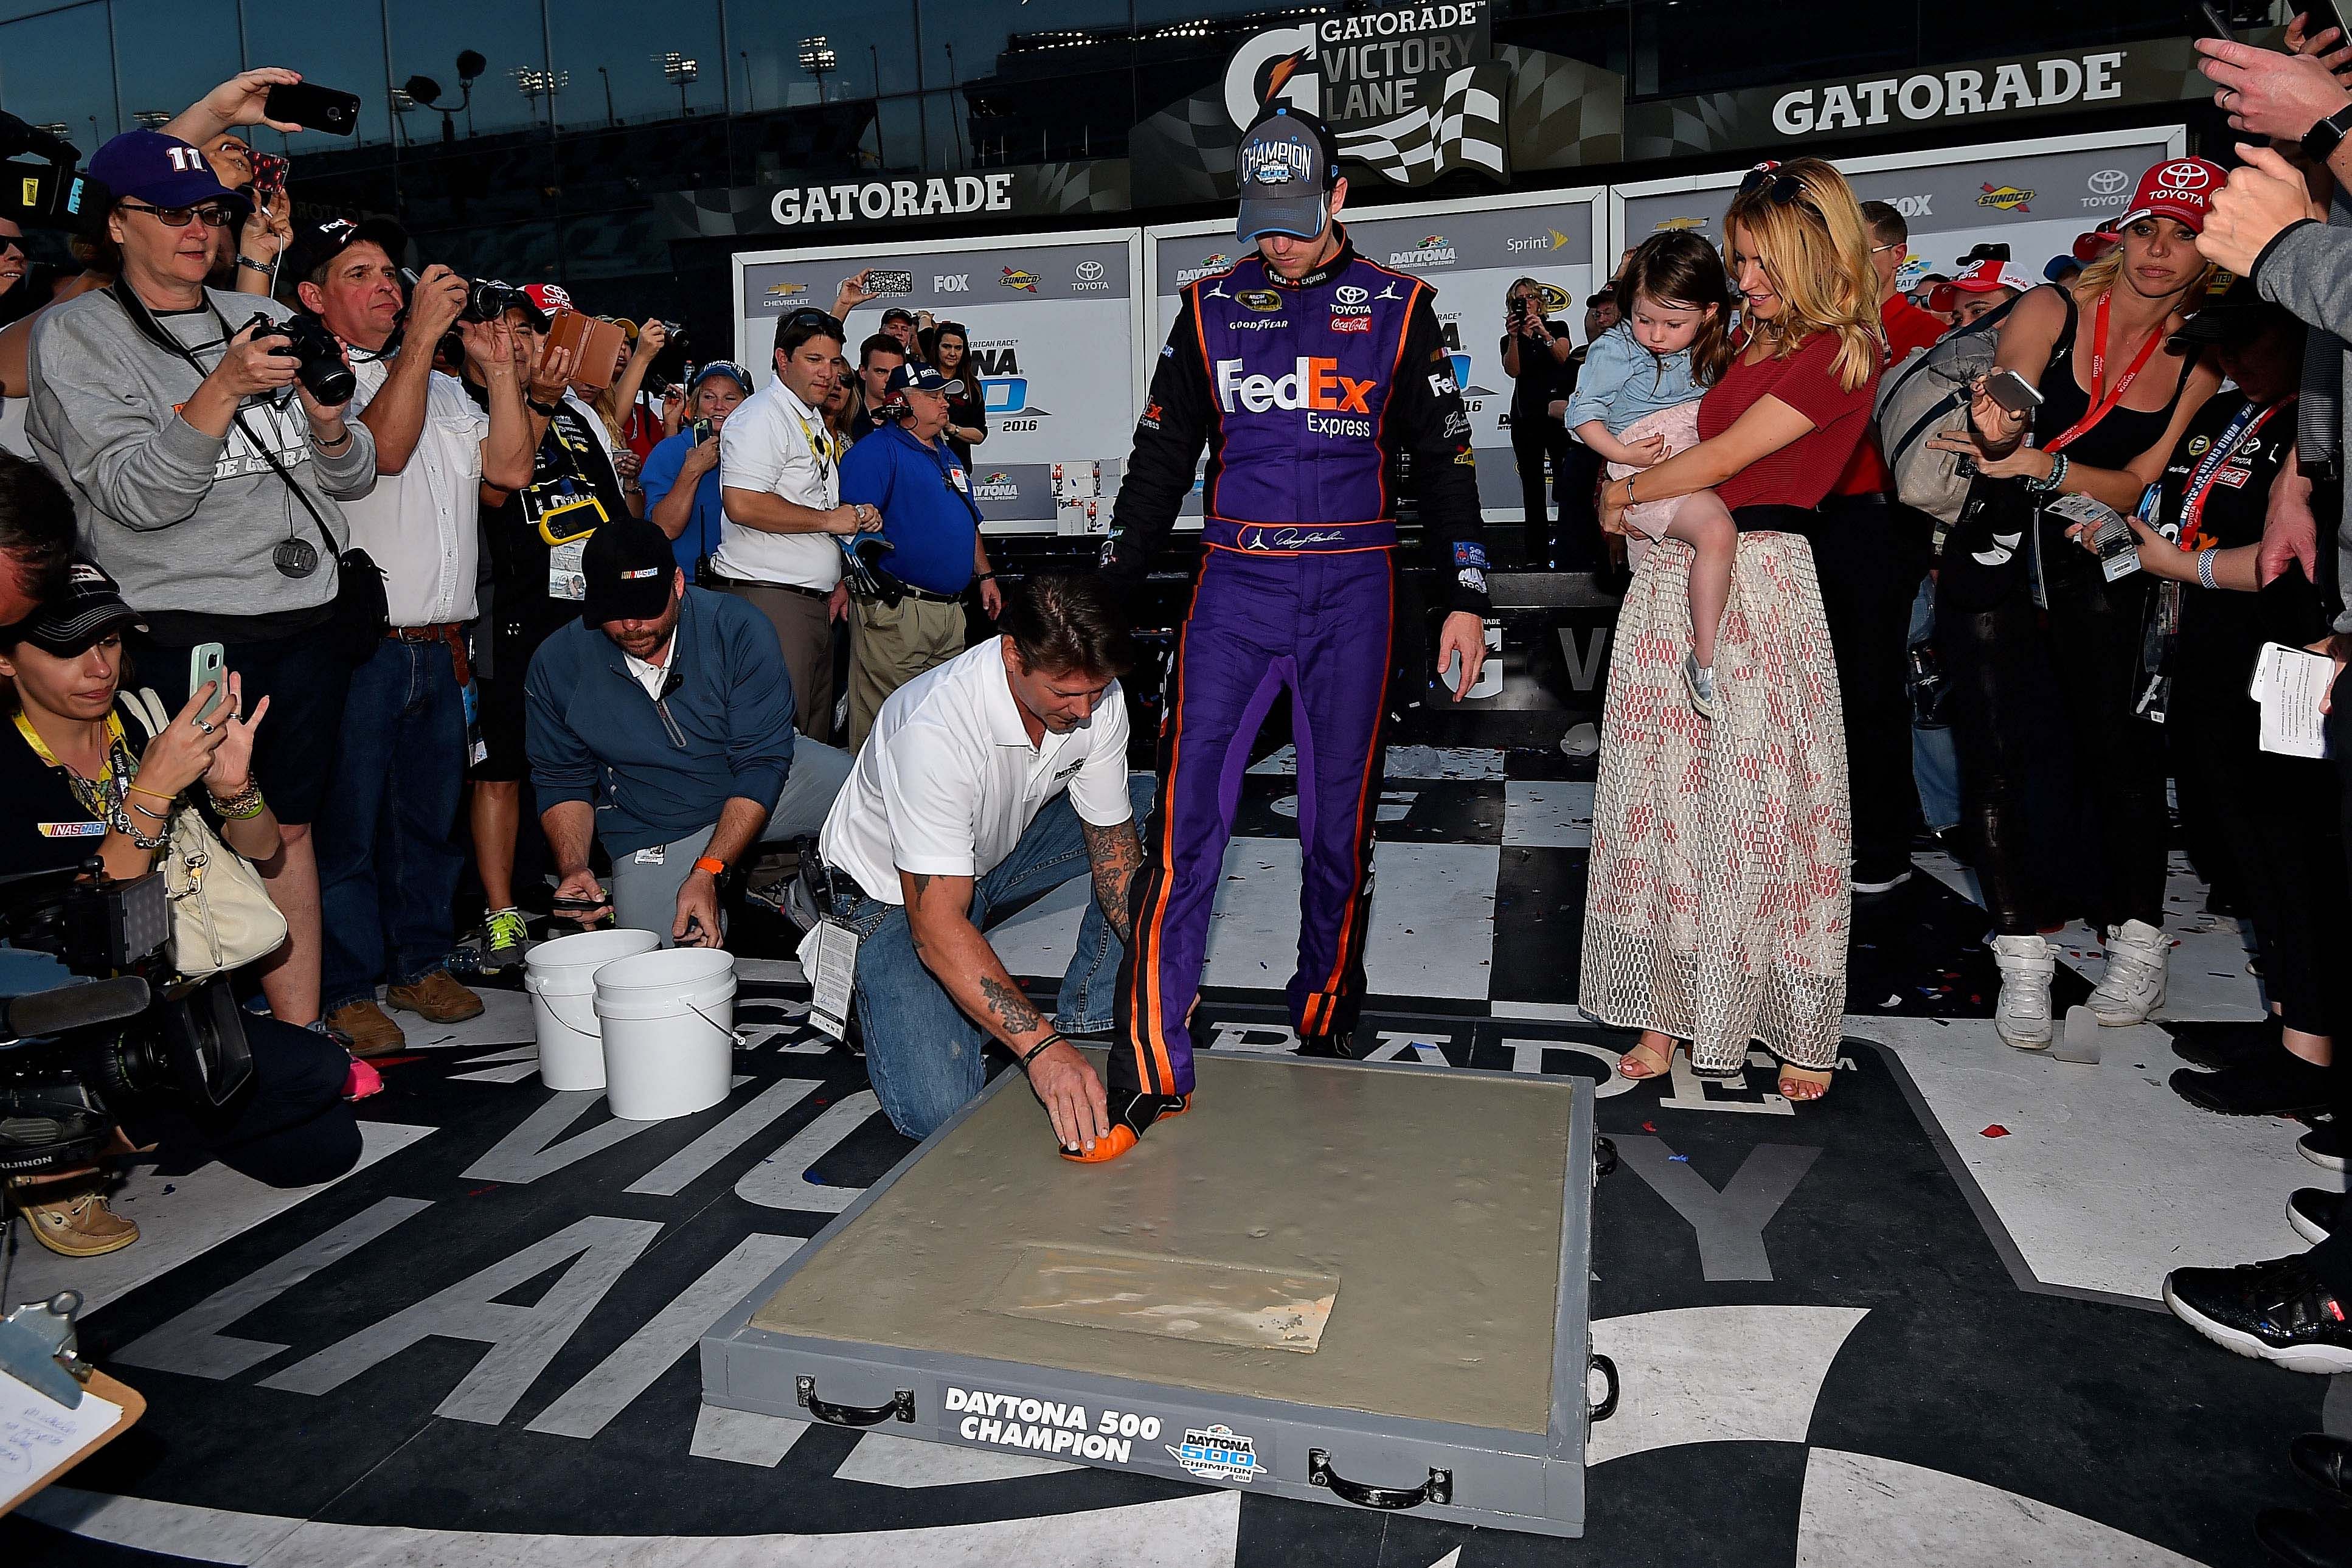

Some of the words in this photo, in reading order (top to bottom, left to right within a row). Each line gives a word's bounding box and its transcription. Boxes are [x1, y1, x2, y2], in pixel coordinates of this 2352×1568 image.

[1320, 2, 1476, 42] GATORADE
[1322, 31, 1476, 83] VICTORY
[1326, 78, 1417, 122] LANE
[1772, 52, 2121, 135] GATORADE
[166, 147, 207, 172] 11
[1242, 140, 1311, 182] CHAMPION
[771, 174, 1011, 225] GATORADE
[1979, 191, 2033, 206] SUNOCO
[2149, 189, 2204, 207] TOYOTA
[1507, 236, 1548, 253] Sprint
[1389, 248, 1456, 264] DAYTONA
[934, 274, 969, 293] FOX
[1002, 275, 1039, 284] SUNOCO
[1071, 282, 1109, 291] TOYOTA
[763, 298, 809, 307] CHEVROLET
[1330, 304, 1371, 313] TOYOTA
[1230, 320, 1288, 331] GOODYEAR
[1216, 357, 1376, 413] FedEx
[2118, 372, 2135, 392] TOYOTA
[1002, 420, 1038, 432] 2016
[1308, 412, 1370, 439] Express
[2221, 423, 2241, 449] WORLD
[2199, 448, 2222, 474] CENTER
[1052, 463, 1063, 497] FedEx
[1093, 460, 1101, 496] FedEx
[1058, 499, 1083, 508] FedEx
[1088, 501, 1097, 532] FedEx
[2187, 505, 2196, 527] TOYOTA
[114, 754, 126, 774] Sprint
[56, 824, 106, 834] NASCAR
[945, 1387, 1088, 1431] DAYTONA
[1098, 1410, 1161, 1440] 500
[959, 1417, 1133, 1463] CHAMPION
[1186, 1434, 1251, 1452] DAYTONA
[1181, 1445, 1254, 1466] 500
[1182, 1460, 1252, 1475] CHAMPION
